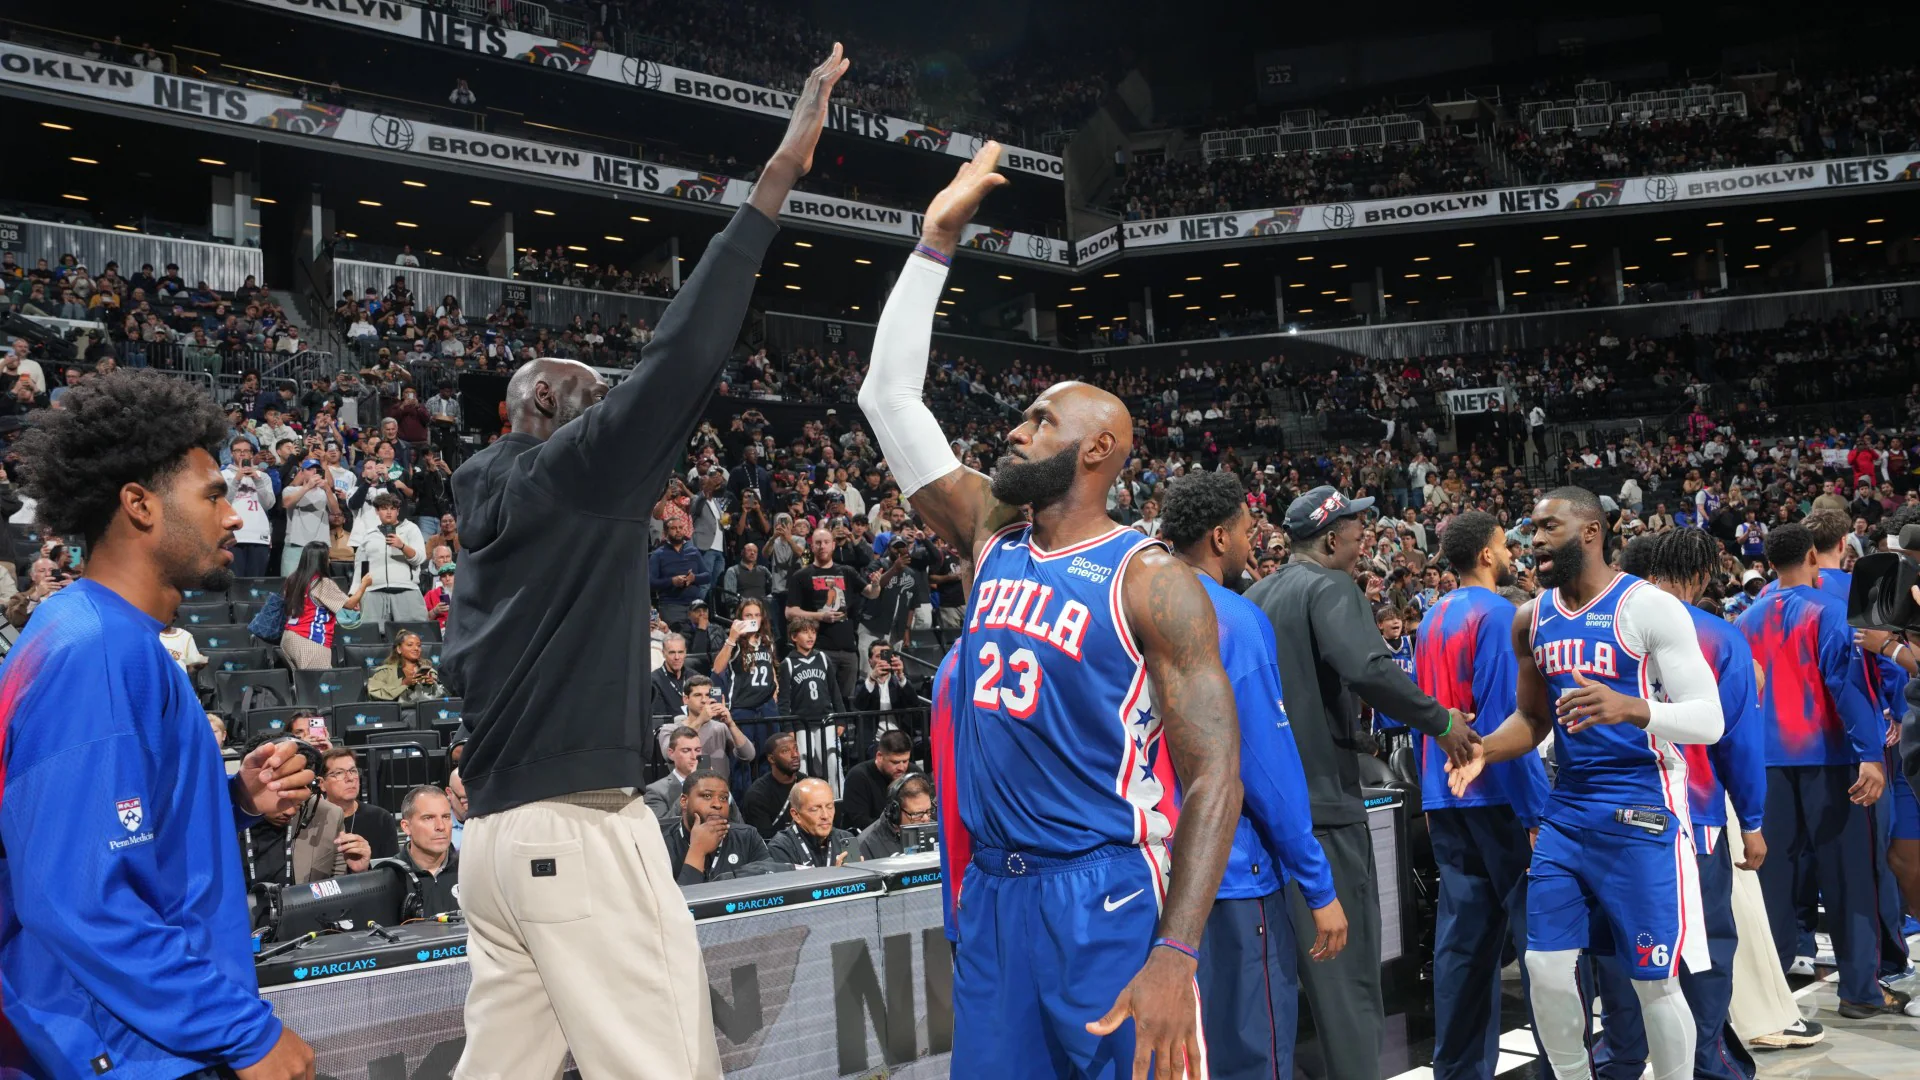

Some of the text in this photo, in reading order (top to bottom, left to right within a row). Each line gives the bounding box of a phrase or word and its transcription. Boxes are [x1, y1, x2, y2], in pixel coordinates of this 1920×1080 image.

[420, 8, 507, 57] NETS
[1267, 72, 1292, 84] 212
[153, 75, 247, 120] NETS
[674, 77, 889, 141] BROOKLY NETS
[427, 136, 660, 191] BROOKLYN NETS
[1688, 160, 1889, 196] BROOKLYN NETS
[789, 199, 902, 225] BROOKLYN
[1364, 188, 1559, 223] BROOKLYN NETS
[1180, 216, 1238, 240] NETS
[508, 290, 525, 300] 109
[1453, 392, 1500, 411] NETS
[247, 500, 258, 511] 21
[1067, 566, 1108, 584] energy
[1072, 556, 1112, 575] Bloom
[969, 578, 1092, 662] PHILA
[1585, 620, 1612, 628] energy
[1586, 612, 1612, 620] Bloom
[1533, 638, 1620, 679] PHILA
[750, 665, 768, 686] 22
[793, 668, 826, 684] BROOKLYN
[973, 641, 1043, 719] 23
[808, 680, 819, 700] 8
[109, 832, 154, 850] Penn Medicin
[319, 879, 342, 897] NBA
[823, 883, 866, 898] BARCLAYS
[737, 896, 784, 911] BARCLAYS
[432, 945, 467, 960] BARC
[1636, 944, 1669, 967] 76
[311, 958, 376, 977] BARCLAYS
